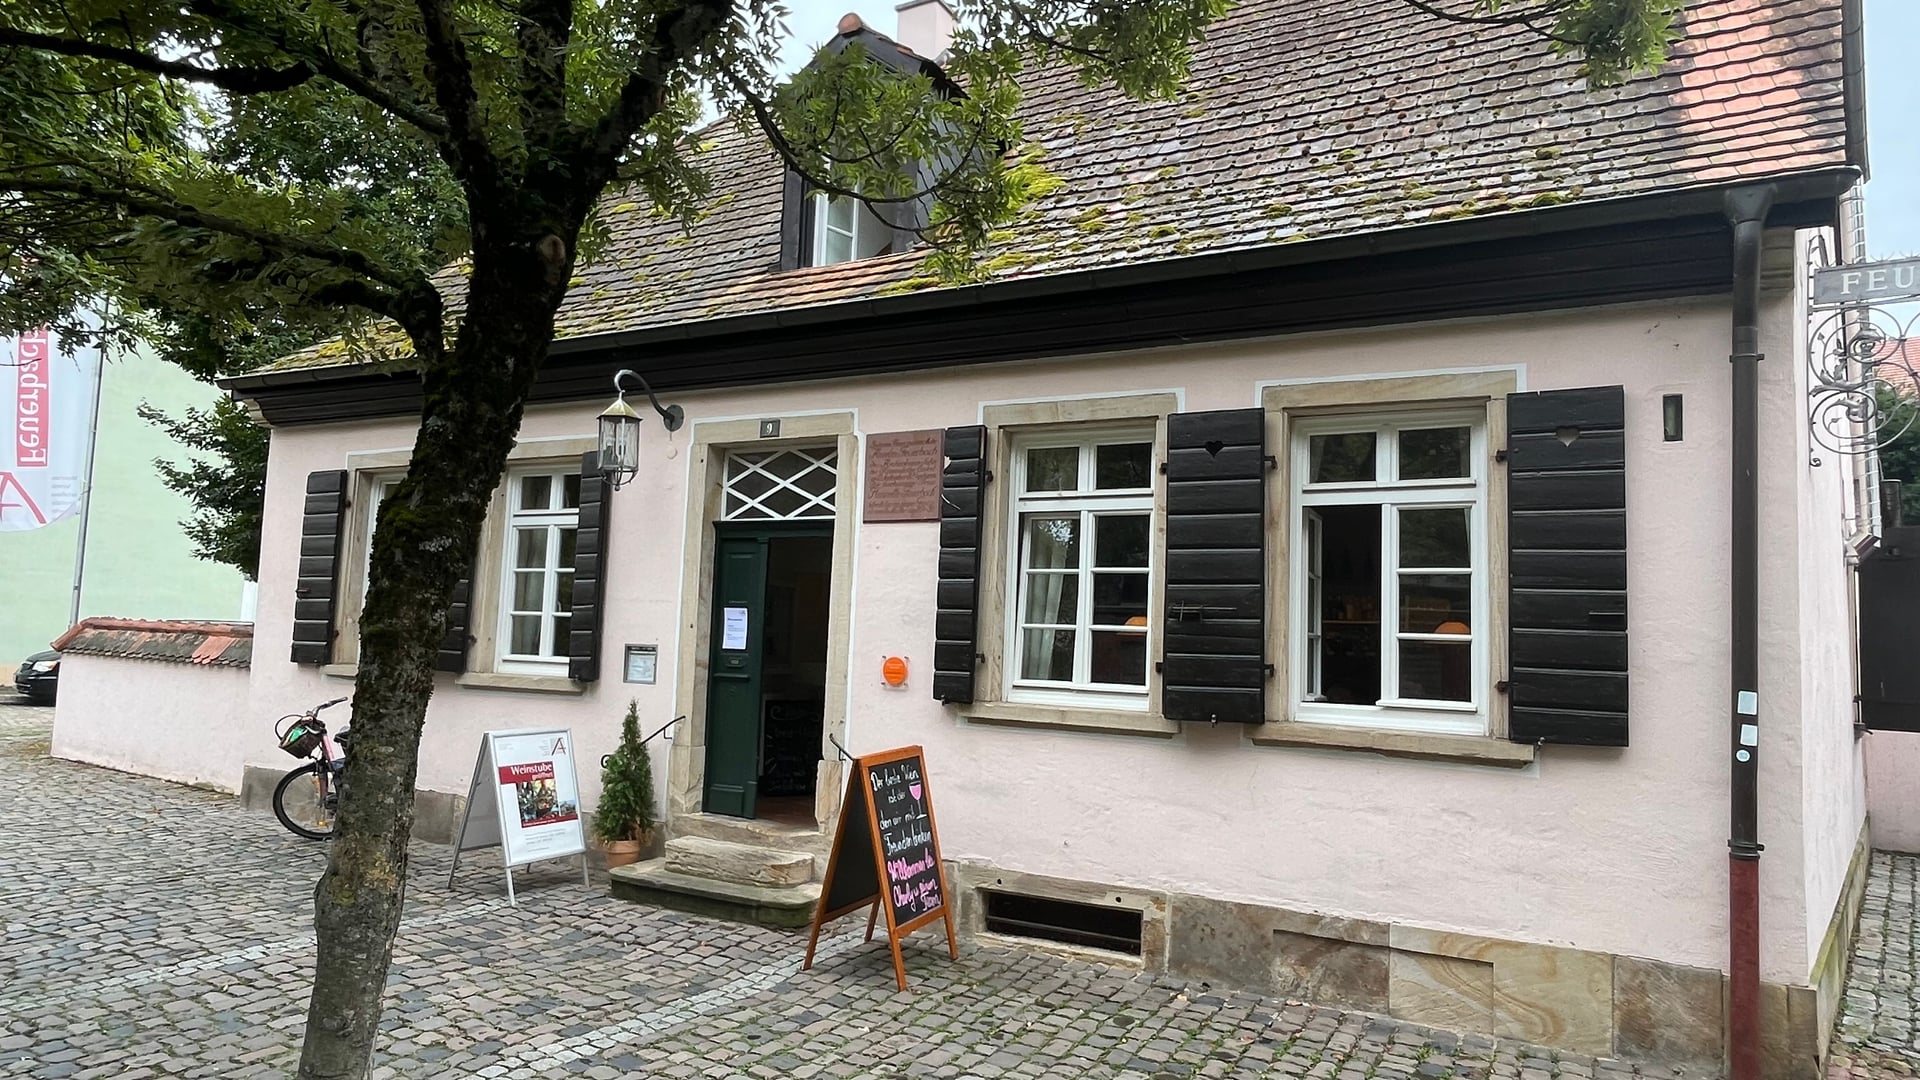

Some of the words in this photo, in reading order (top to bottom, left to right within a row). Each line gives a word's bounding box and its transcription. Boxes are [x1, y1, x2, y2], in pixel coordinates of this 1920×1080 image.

[766, 422, 773, 435] 9
[510, 763, 552, 775] Weinstube
[870, 771, 884, 791] Der
[885, 768, 901, 786] beste
[901, 764, 919, 780] Wein
[880, 809, 892, 830] den
[887, 856, 926, 882] Willkommen
